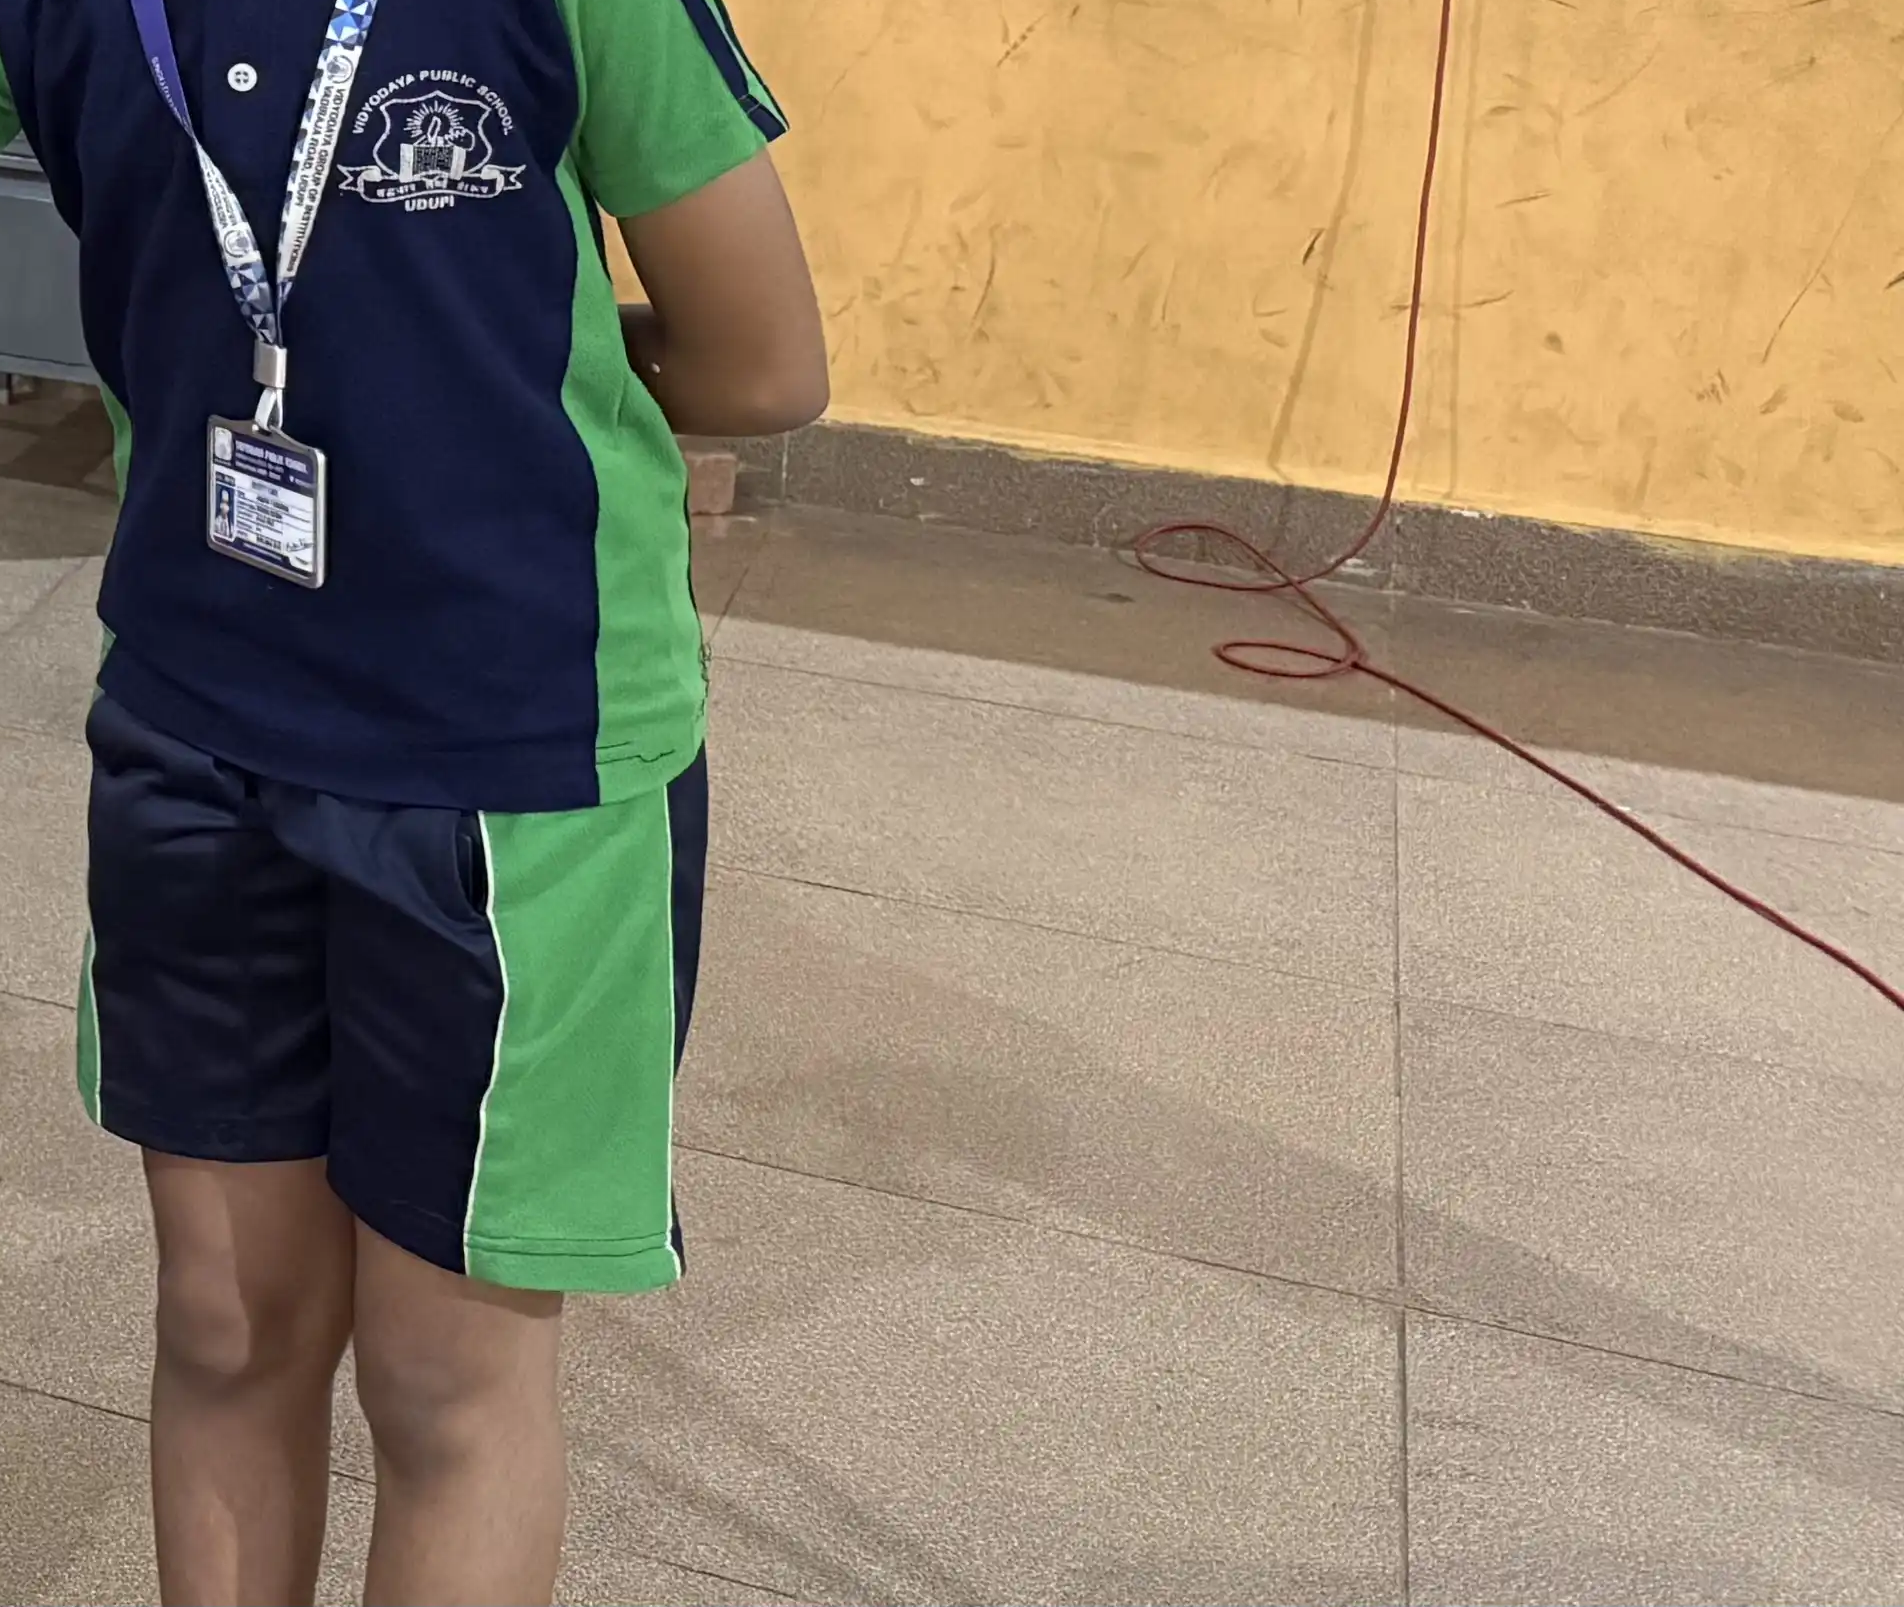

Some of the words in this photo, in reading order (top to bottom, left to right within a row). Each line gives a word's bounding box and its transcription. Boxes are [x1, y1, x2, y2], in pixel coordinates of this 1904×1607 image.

[322, 88, 346, 146] VIDYODAYA
[352, 73, 415, 135] VIDYODAYA
[419, 69, 476, 88] PUBLIC
[476, 85, 516, 135] SCHOOL
[311, 149, 329, 187] GROUP
[307, 189, 319, 203] OF
[404, 195, 455, 212] UDUPI
